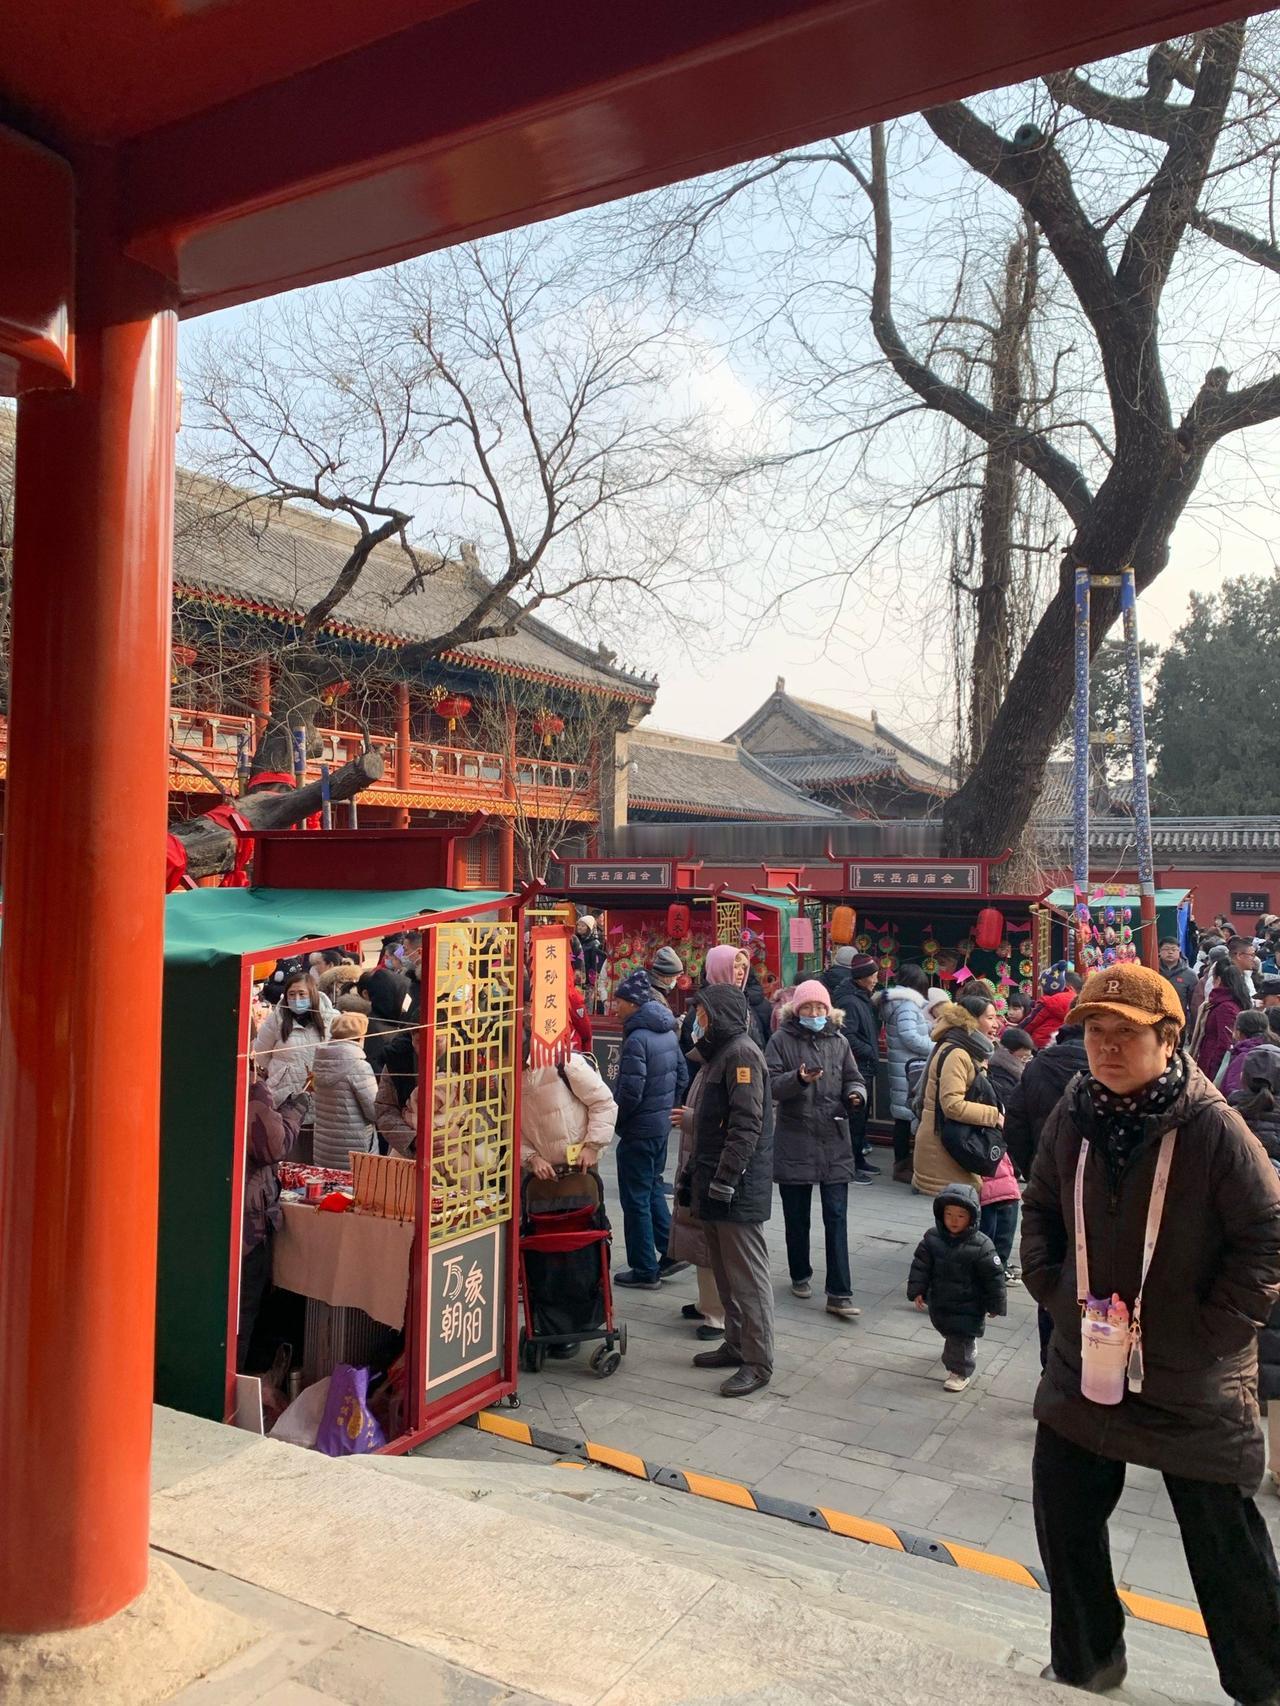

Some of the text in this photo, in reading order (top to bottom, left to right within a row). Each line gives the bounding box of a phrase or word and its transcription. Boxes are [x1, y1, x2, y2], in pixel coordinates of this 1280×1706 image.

[587, 871, 651, 881] 东岳庙庙会
[873, 873, 955, 884] 东岳庙庙会
[544, 945, 558, 1034] 朱砂皮影
